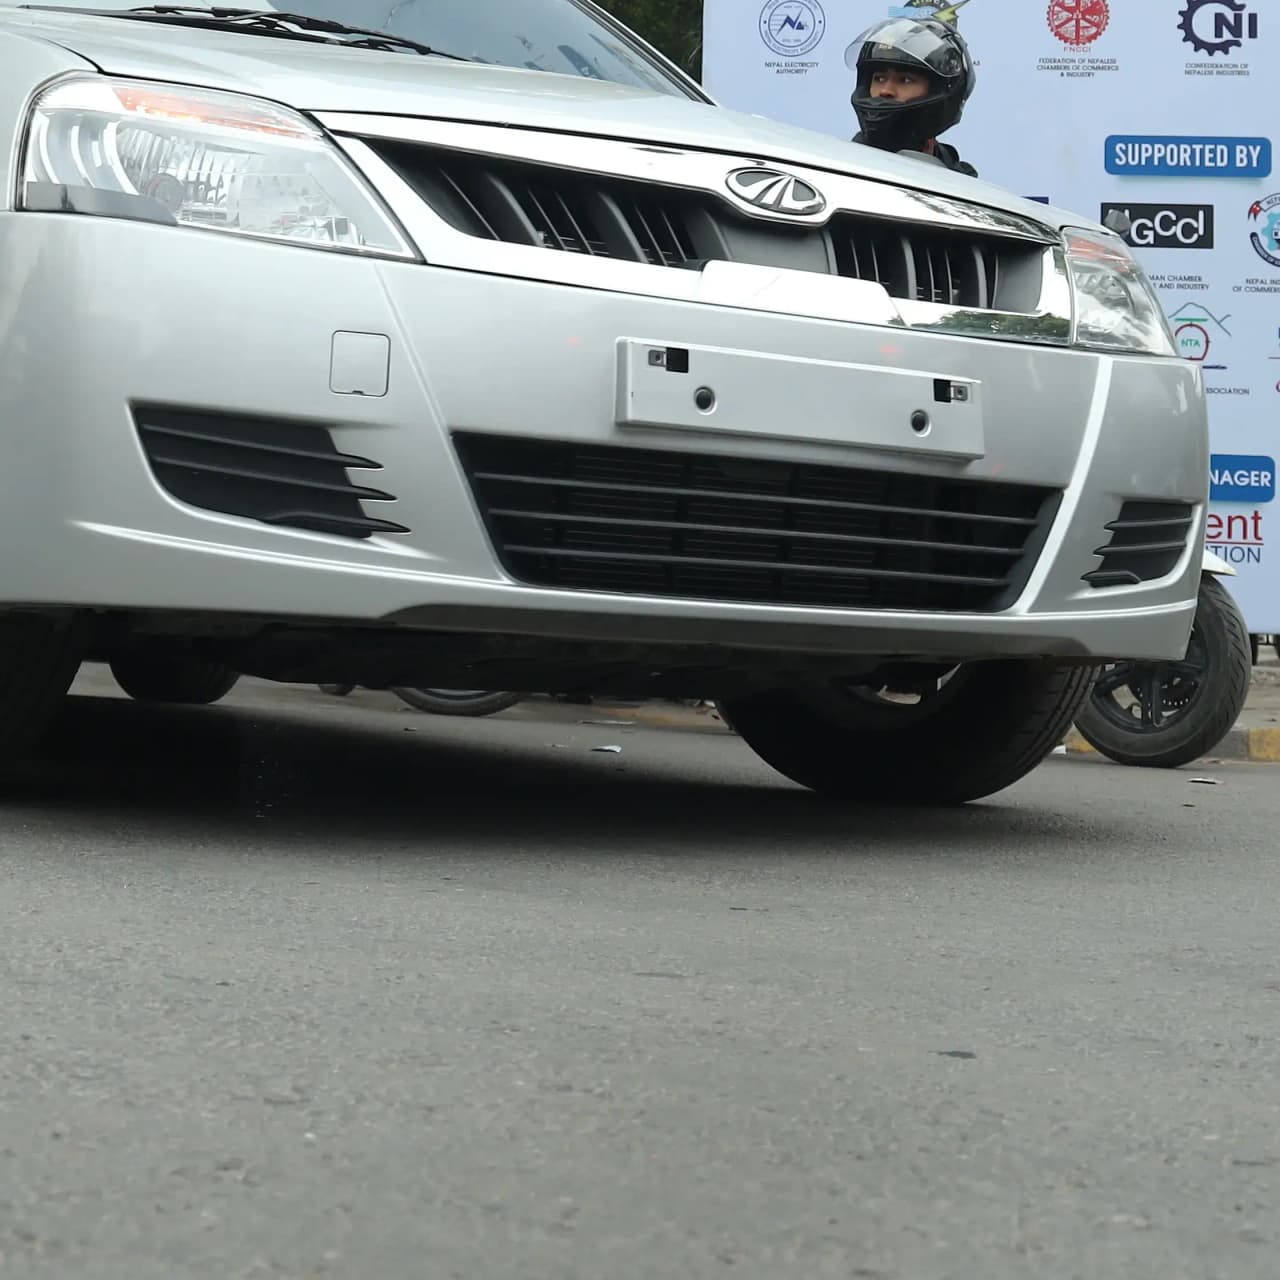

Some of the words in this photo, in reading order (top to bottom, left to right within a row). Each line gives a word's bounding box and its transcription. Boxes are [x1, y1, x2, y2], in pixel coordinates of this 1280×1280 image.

[1115, 143, 1228, 167] SUPPORTED
[1236, 145, 1261, 168] BY
[1108, 208, 1205, 245] GCCI
[1181, 338, 1201, 348] NTA
